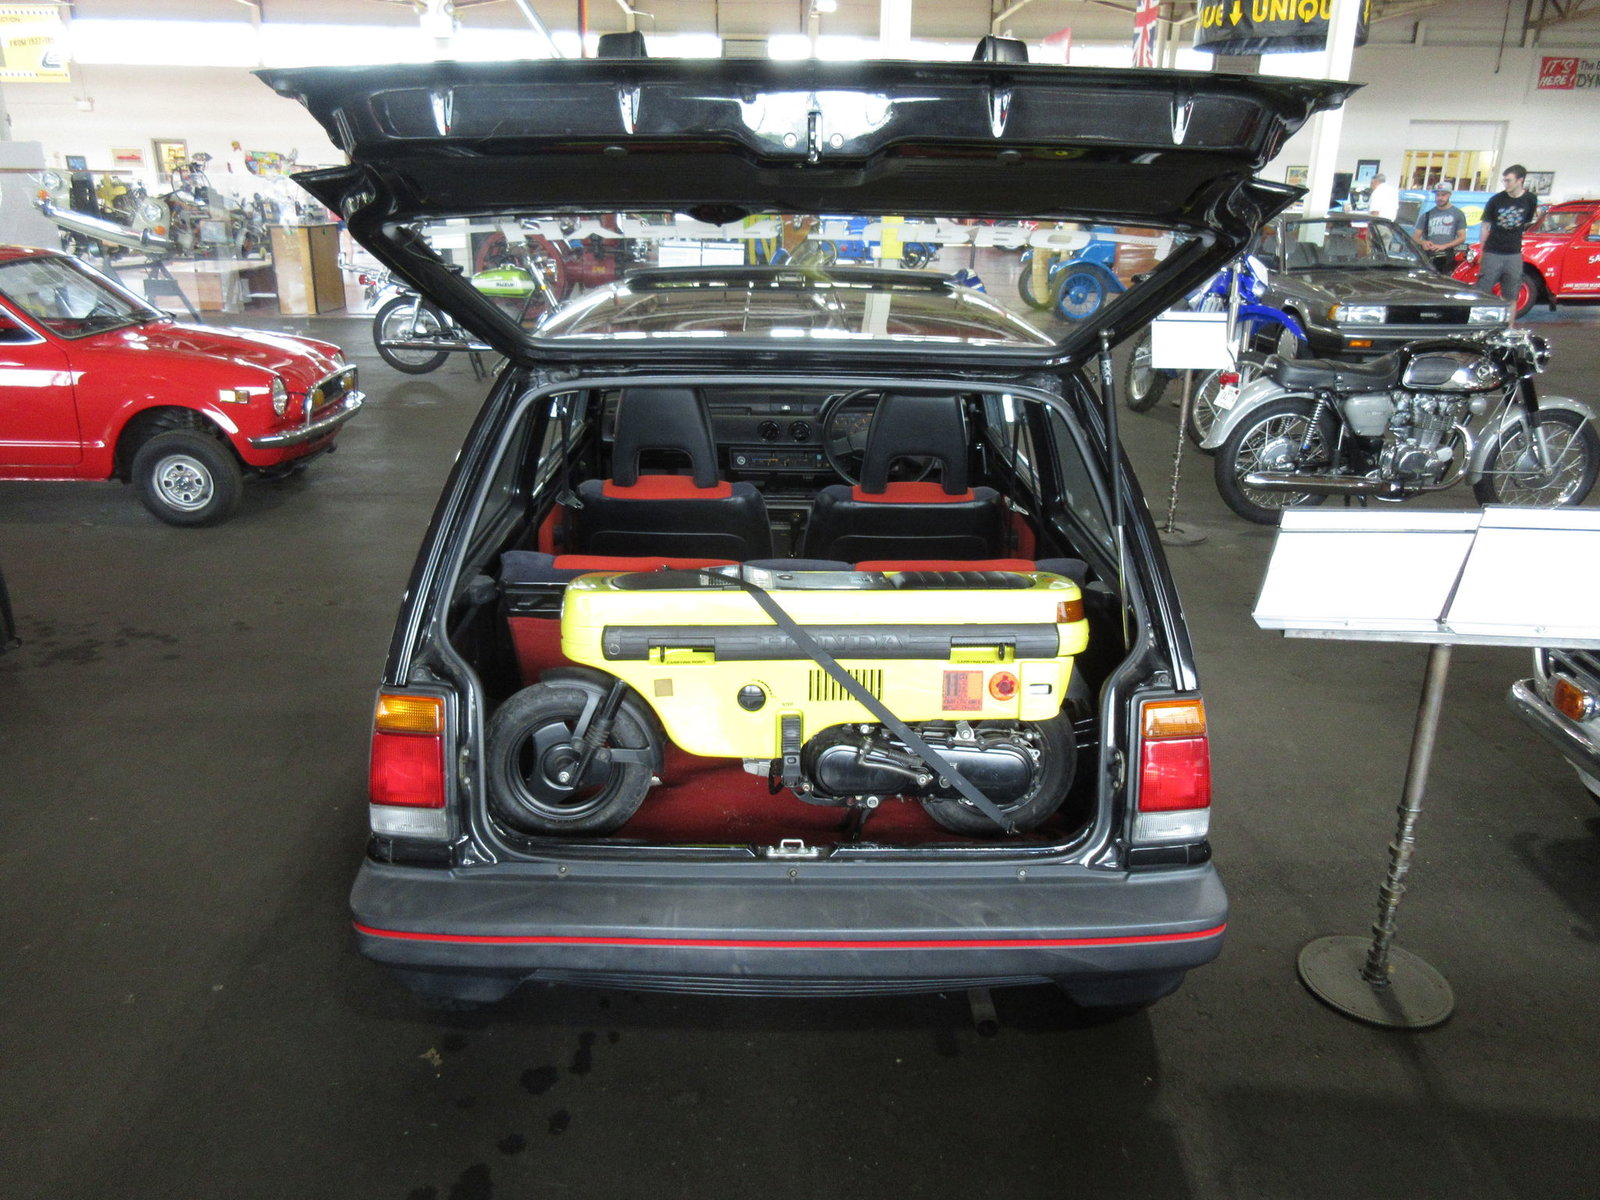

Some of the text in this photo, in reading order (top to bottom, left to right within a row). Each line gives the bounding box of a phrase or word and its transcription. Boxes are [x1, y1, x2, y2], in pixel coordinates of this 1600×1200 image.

[1252, 0, 1332, 23] UNIQU
[1544, 59, 1575, 74] IT'S
[760, 634, 904, 651] HNDA
